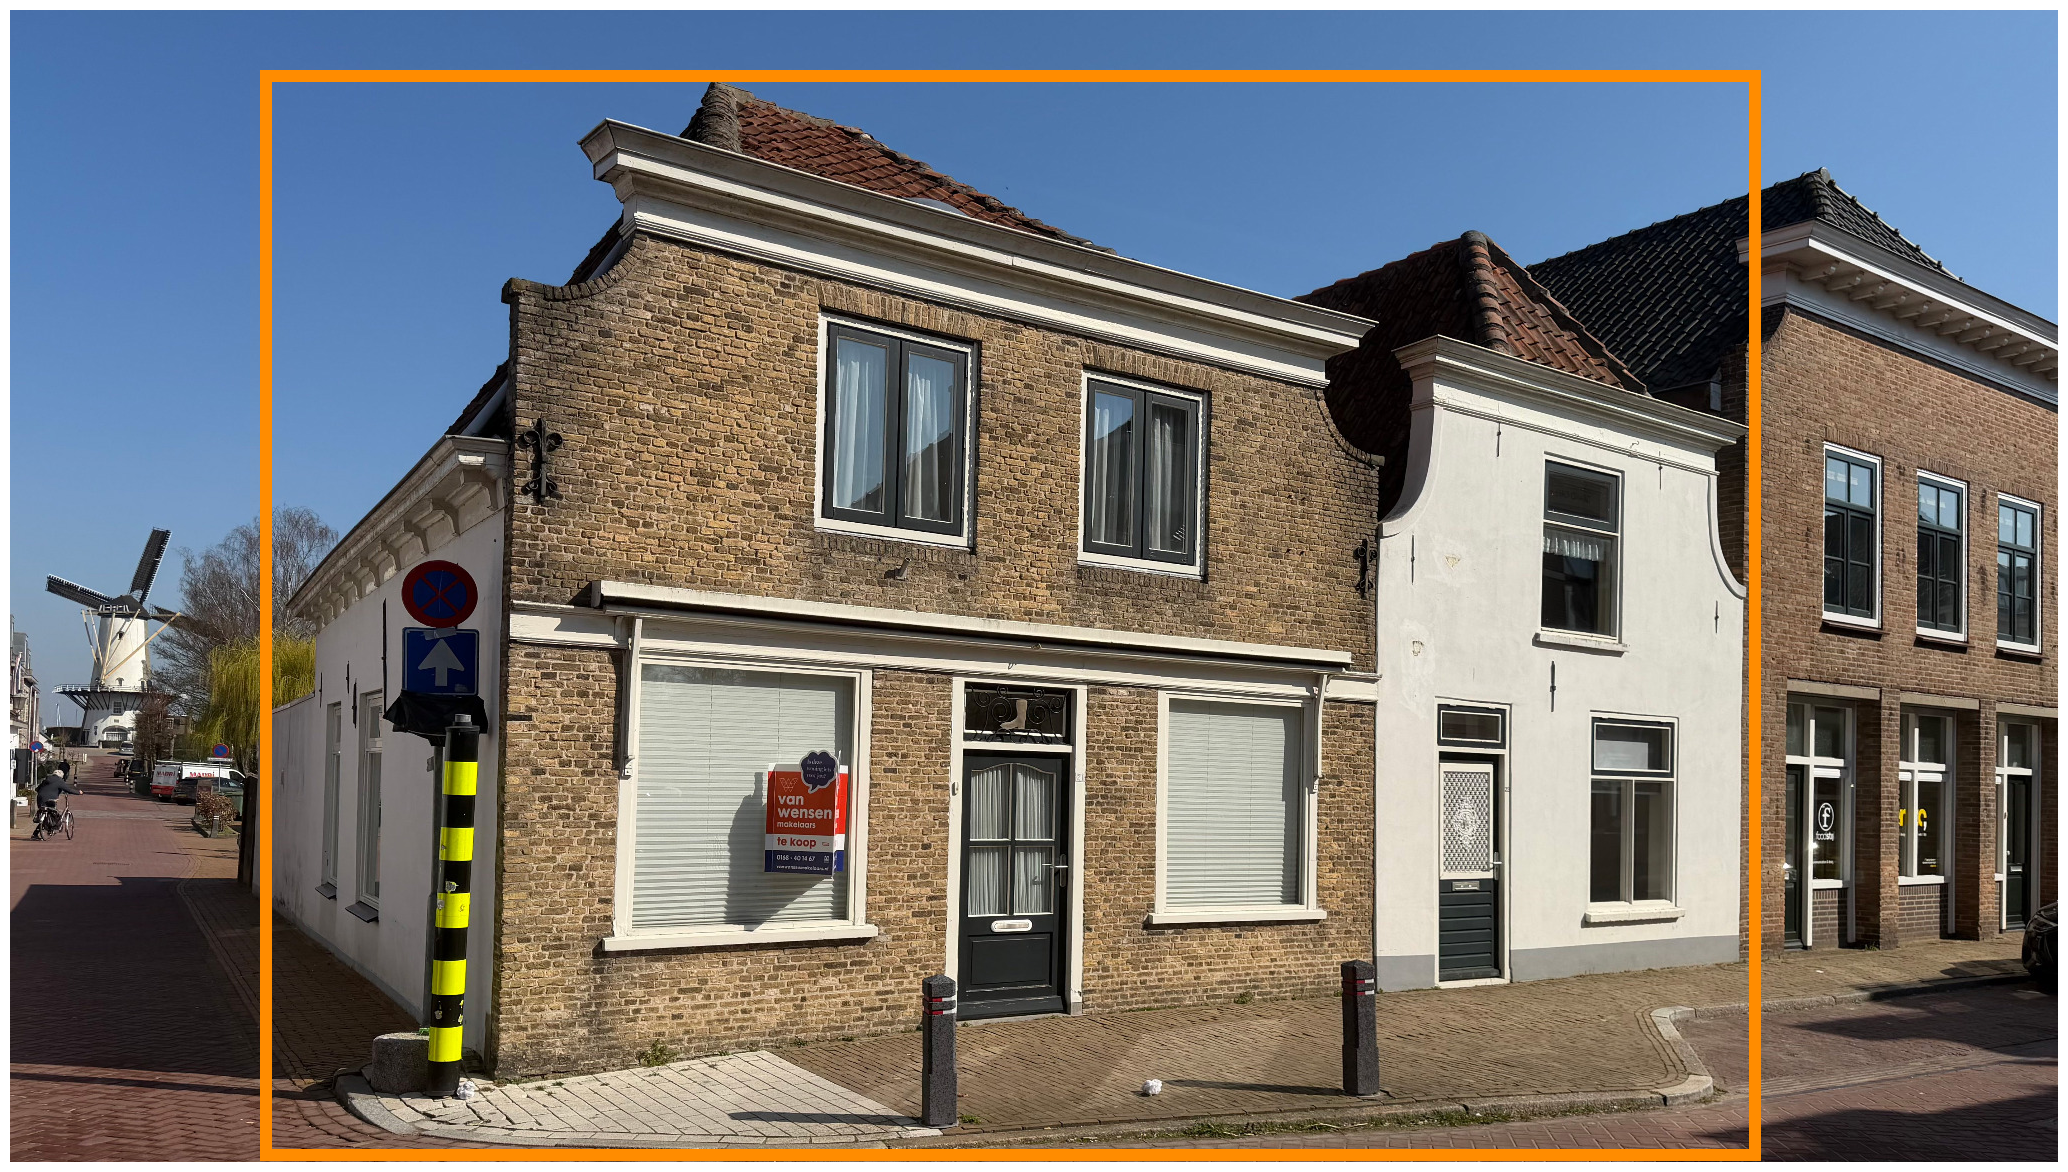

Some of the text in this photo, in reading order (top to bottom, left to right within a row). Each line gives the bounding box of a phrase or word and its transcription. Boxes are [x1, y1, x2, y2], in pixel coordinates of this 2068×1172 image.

[778, 795, 804, 805] van
[778, 808, 833, 820] wensen
[777, 821, 816, 829] makelaars
[777, 837, 788, 846] te
[790, 837, 817, 850] koop
